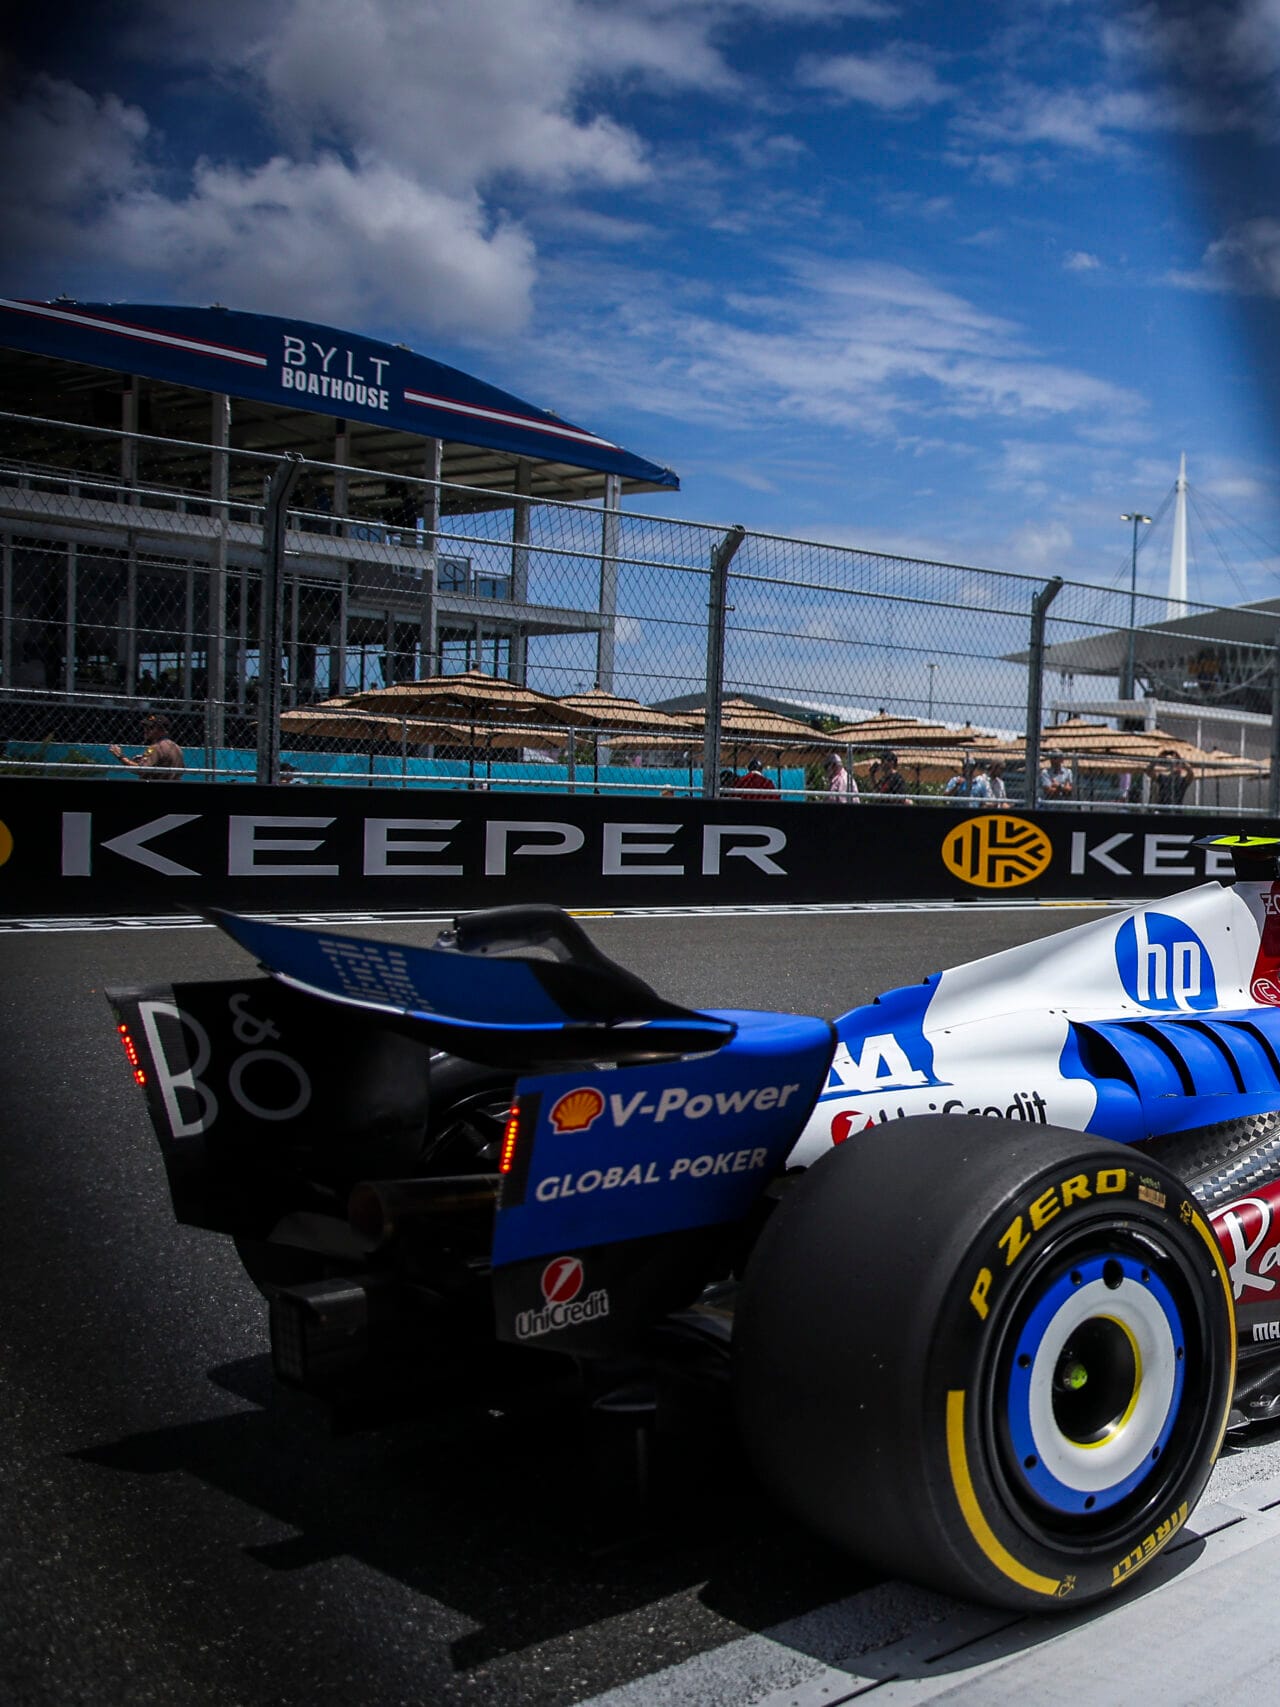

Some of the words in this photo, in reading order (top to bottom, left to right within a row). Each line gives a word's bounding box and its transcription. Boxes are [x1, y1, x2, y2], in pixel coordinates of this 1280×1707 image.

[281, 366, 390, 411] BOATHOUSE
[283, 335, 391, 386] BYLT
[61, 811, 788, 877] KEEPER
[318, 938, 436, 1012] IBM
[1133, 911, 1201, 1012] hp
[609, 1083, 800, 1127] V-Power
[535, 1160, 661, 1202] GLOBAL
[668, 1146, 769, 1181] POKER
[969, 1267, 993, 1321] P
[998, 1168, 1127, 1267] ZERO
[515, 1289, 610, 1340] UniCredit
